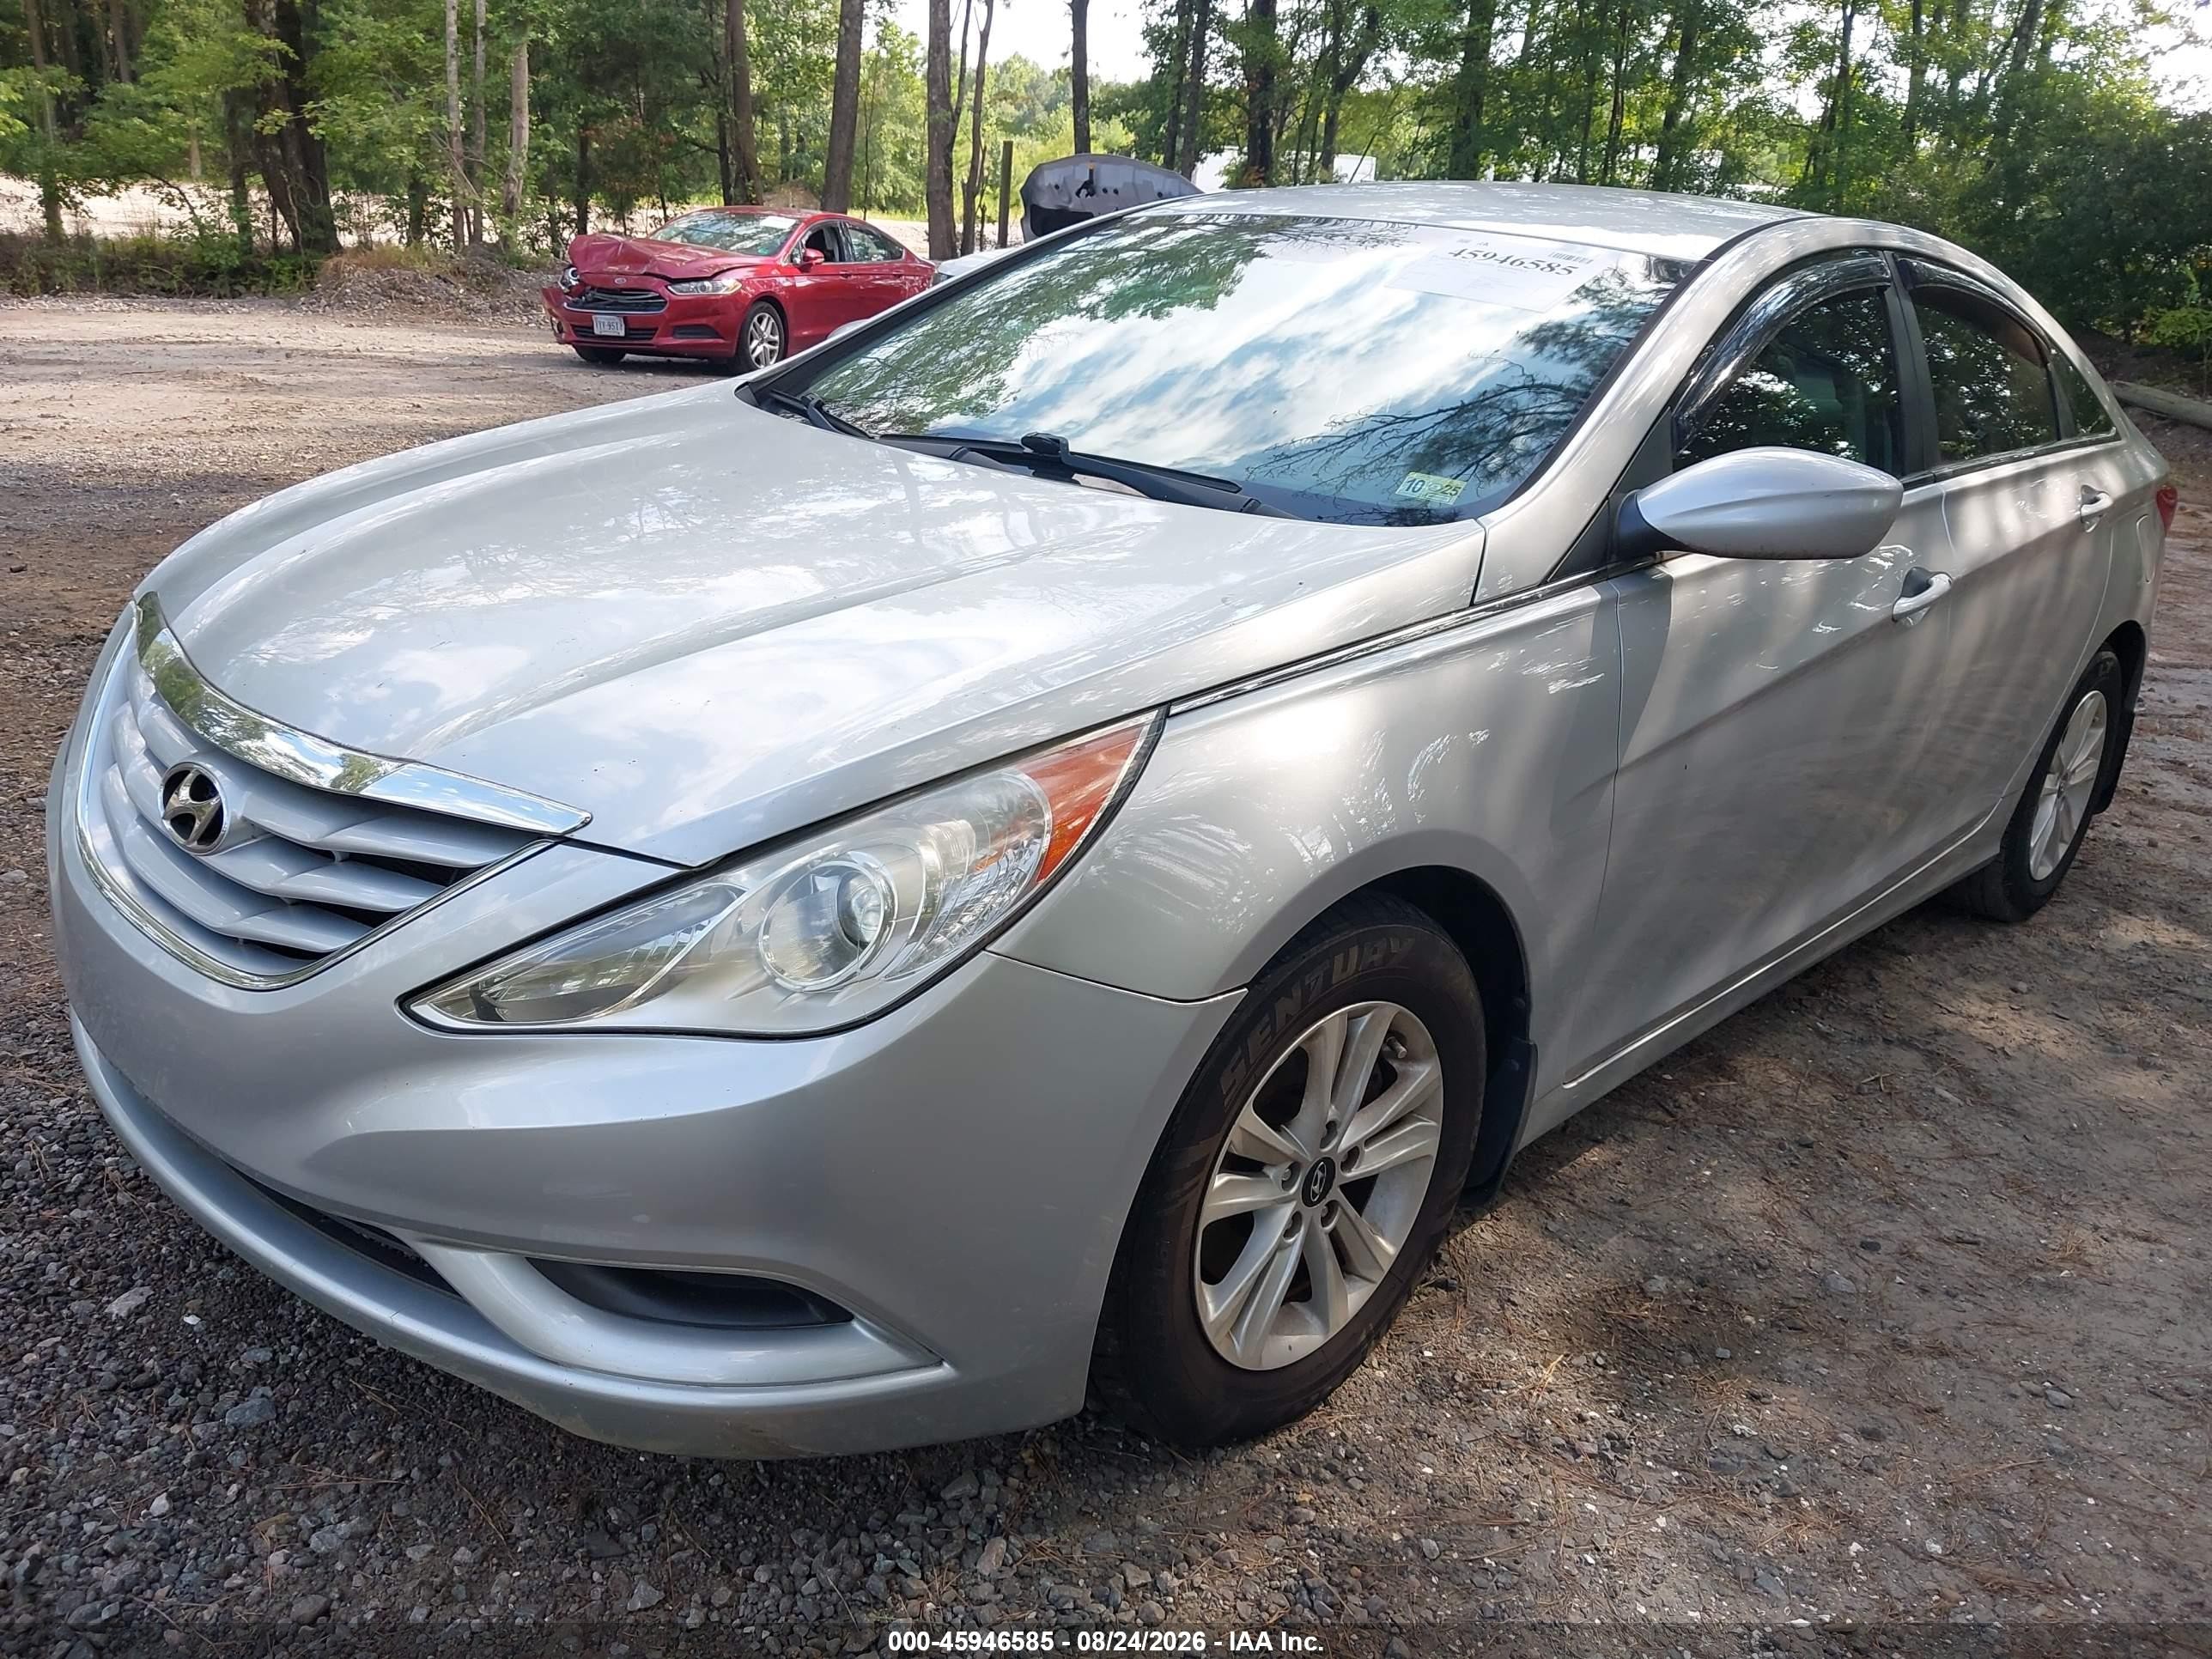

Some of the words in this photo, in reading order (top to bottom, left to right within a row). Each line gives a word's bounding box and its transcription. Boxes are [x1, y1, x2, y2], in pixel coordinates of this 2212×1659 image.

[1449, 248, 1579, 276] 45946585
[1405, 478, 1425, 494] 10
[1440, 484, 1462, 496] 25
